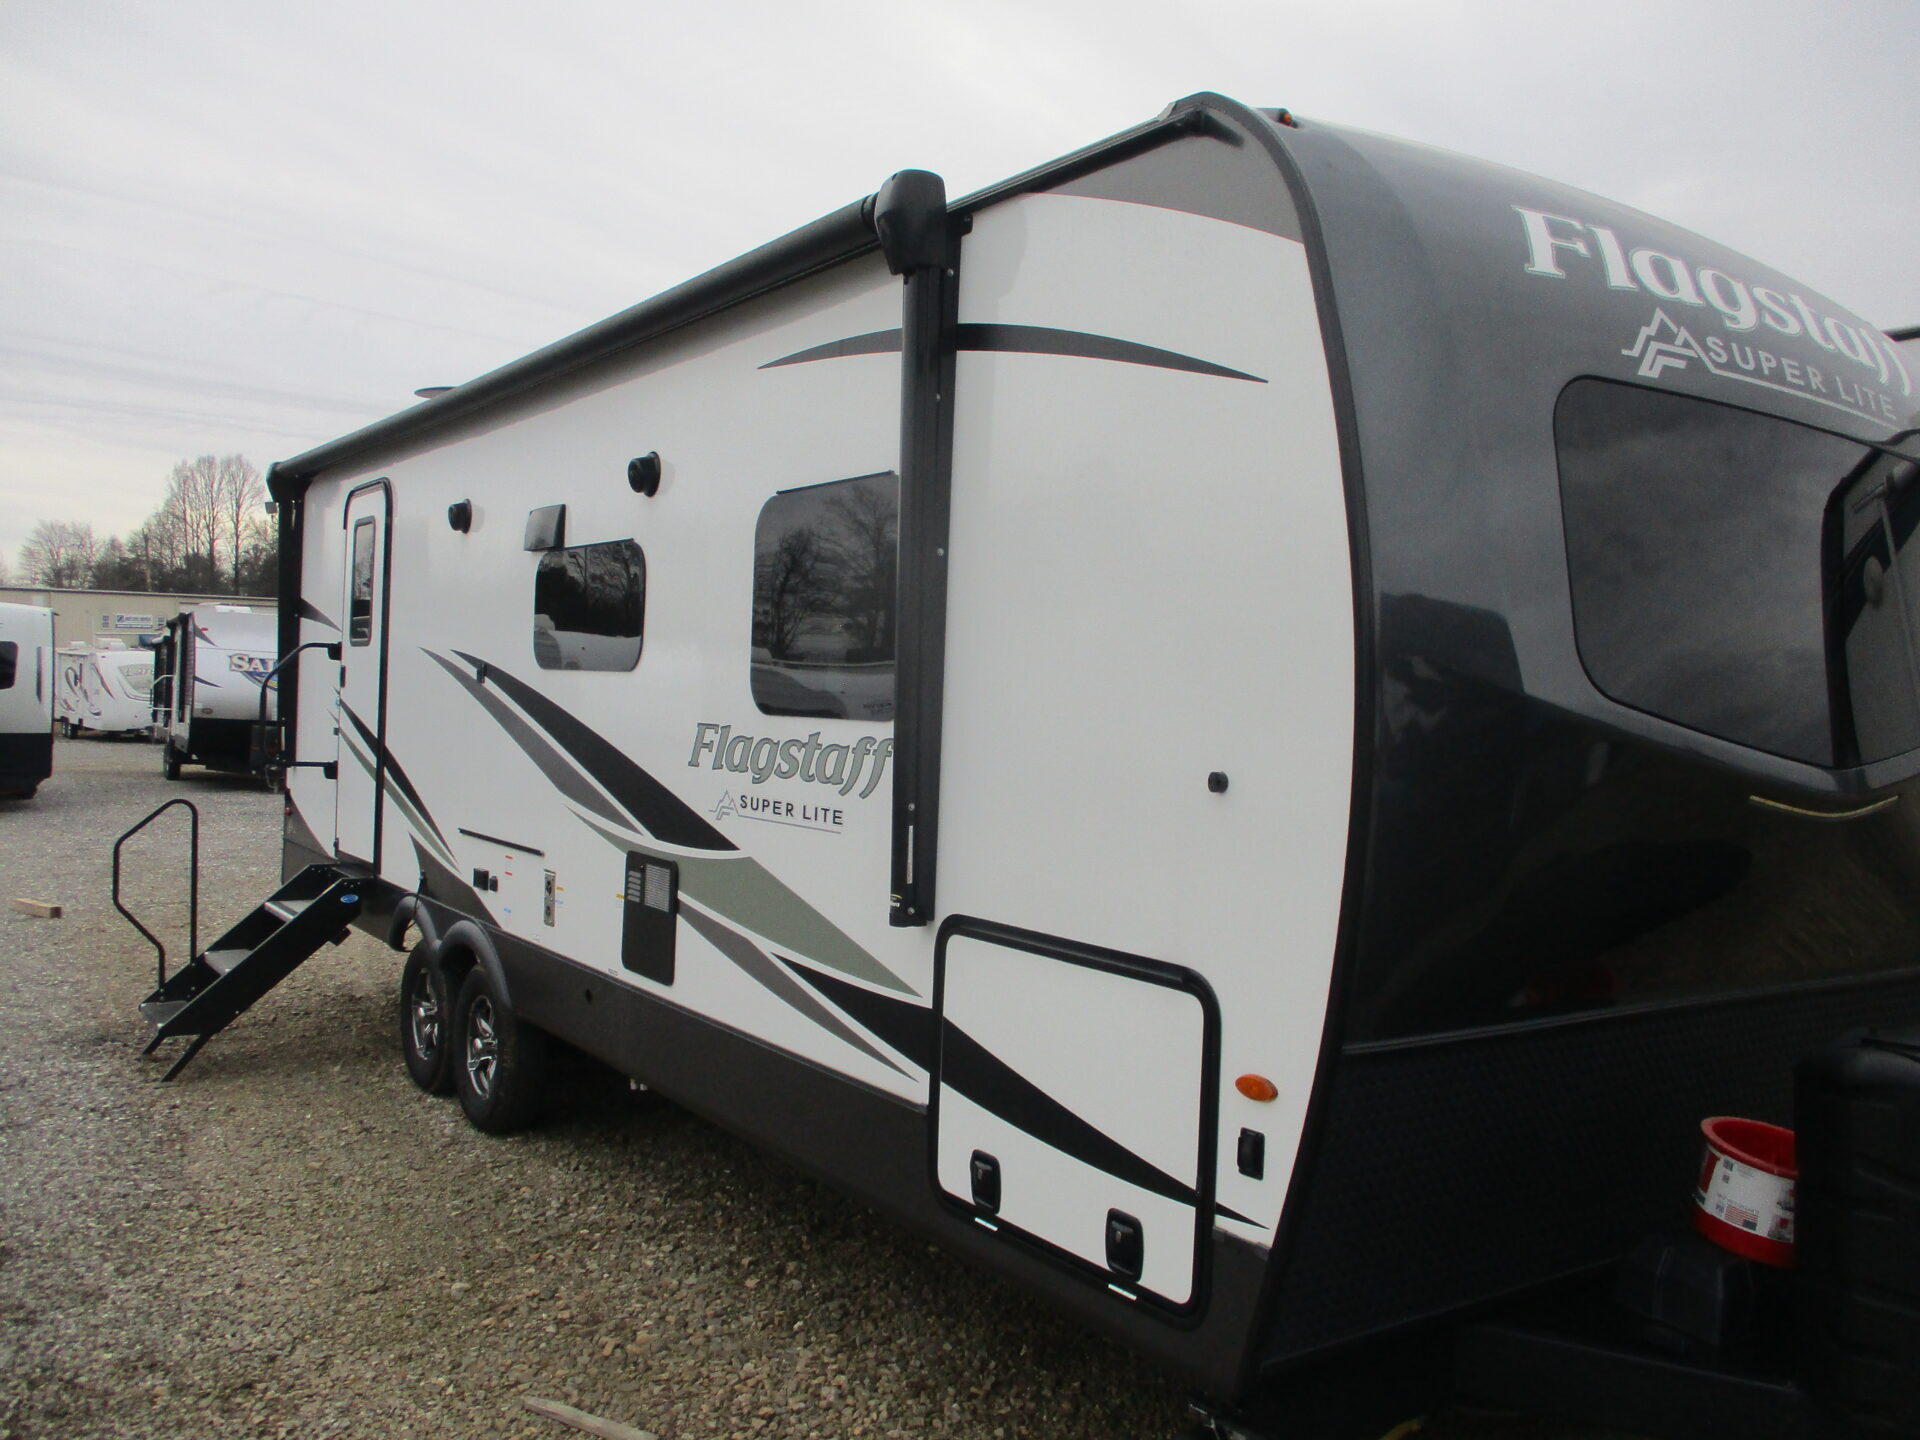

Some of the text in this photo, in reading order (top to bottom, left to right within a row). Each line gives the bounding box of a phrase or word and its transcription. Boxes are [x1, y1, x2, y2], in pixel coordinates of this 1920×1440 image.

[1511, 204, 1911, 396] Flagstaff
[1708, 336, 1897, 420] SUPER LITE
[688, 722, 894, 799] Flagstaff
[739, 794, 845, 826] SUPER LITE
